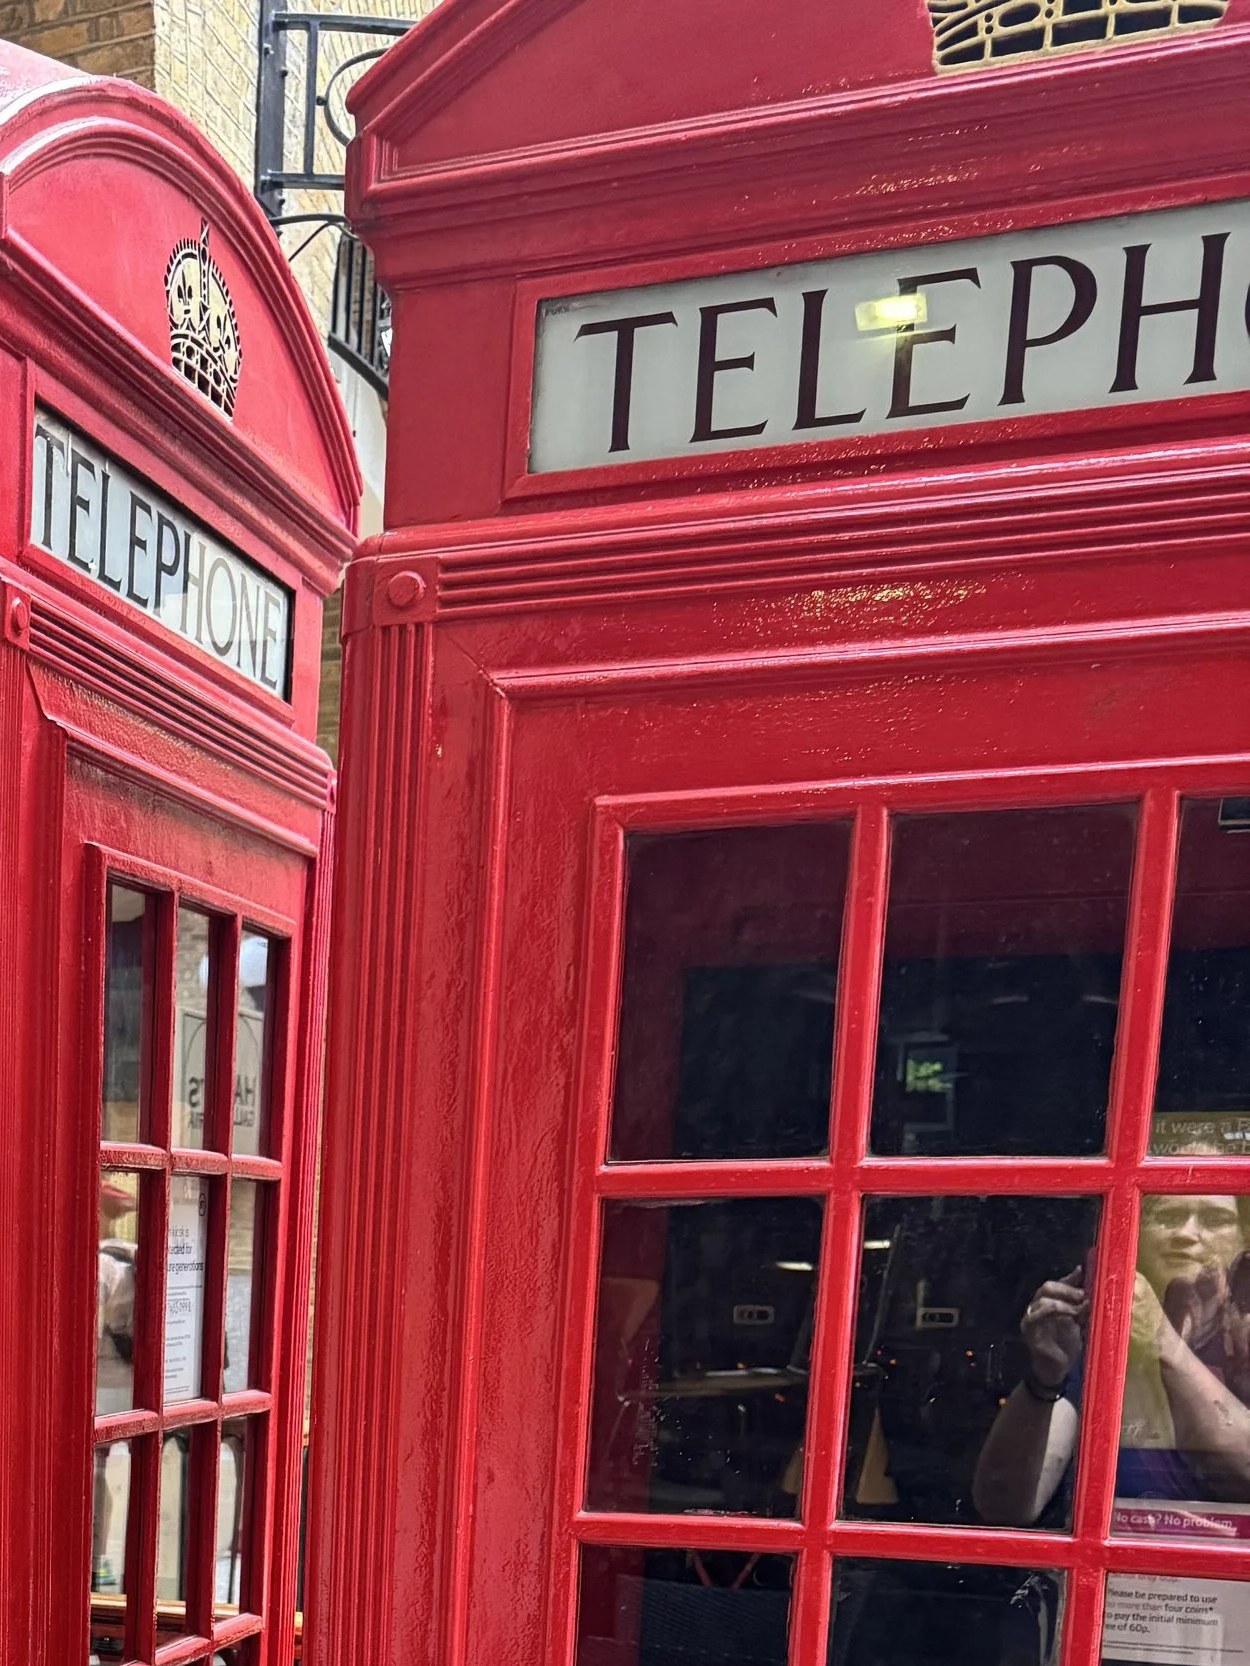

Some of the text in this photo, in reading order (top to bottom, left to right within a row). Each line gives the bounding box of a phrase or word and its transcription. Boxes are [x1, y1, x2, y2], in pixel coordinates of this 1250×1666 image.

[574, 232, 1250, 454] TELEPH
[33, 423, 282, 690] TELEPHONE
[1164, 1514, 1181, 1526] No
[1135, 1590, 1146, 1599] be
[1147, 1591, 1188, 1603] prepared
[1190, 1594, 1199, 1603] to
[1201, 1595, 1217, 1604] use
[1164, 1603, 1183, 1613] four
[1114, 1612, 1131, 1622] pay
[1132, 1611, 1147, 1621] the
[1149, 1613, 1174, 1624] initial
[1129, 1622, 1151, 1634] 60p.
